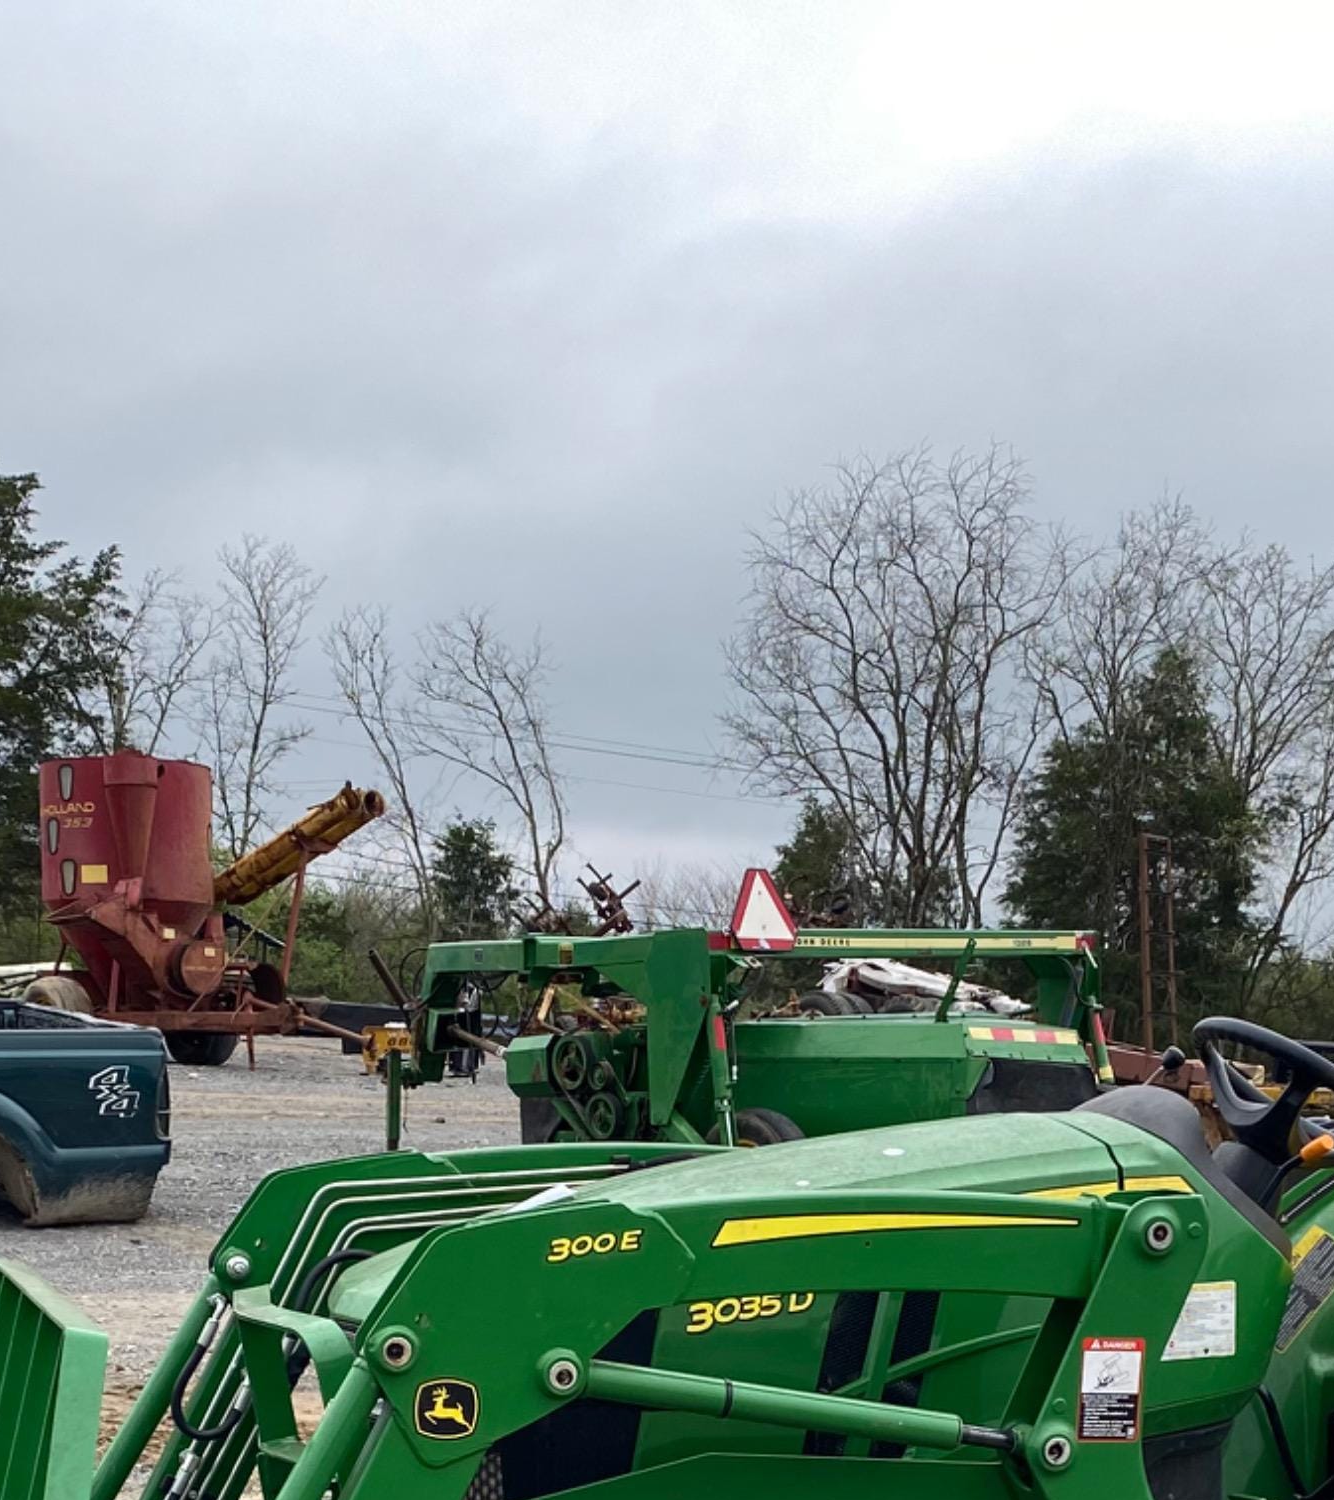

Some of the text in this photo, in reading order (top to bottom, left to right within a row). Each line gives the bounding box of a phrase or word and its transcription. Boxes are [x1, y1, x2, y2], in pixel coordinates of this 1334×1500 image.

[796, 937, 815, 947] OHN
[546, 1229, 643, 1263] 300 E
[685, 1292, 815, 1334] 3035 D
